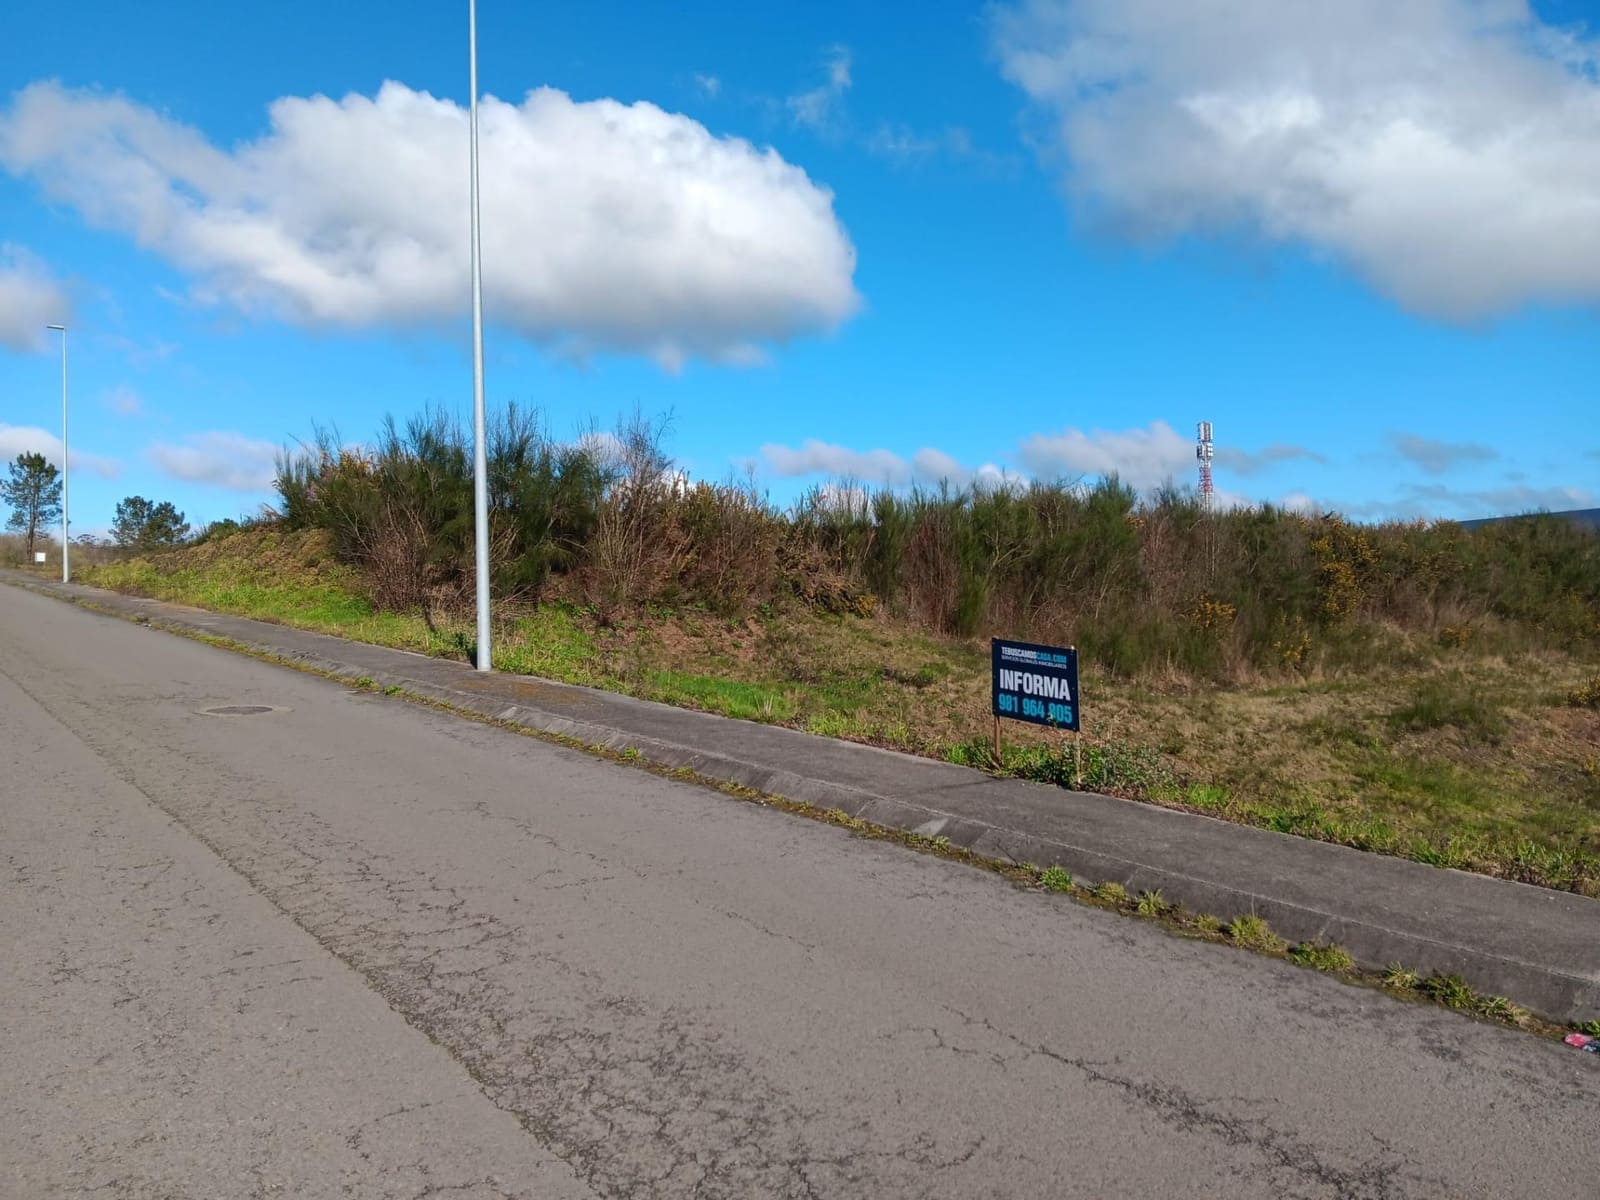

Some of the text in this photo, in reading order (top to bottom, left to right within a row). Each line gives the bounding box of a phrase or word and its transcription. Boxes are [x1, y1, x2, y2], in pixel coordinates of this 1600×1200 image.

[999, 668, 1071, 701] INFORMA
[998, 693, 1073, 723] 981 964 805
